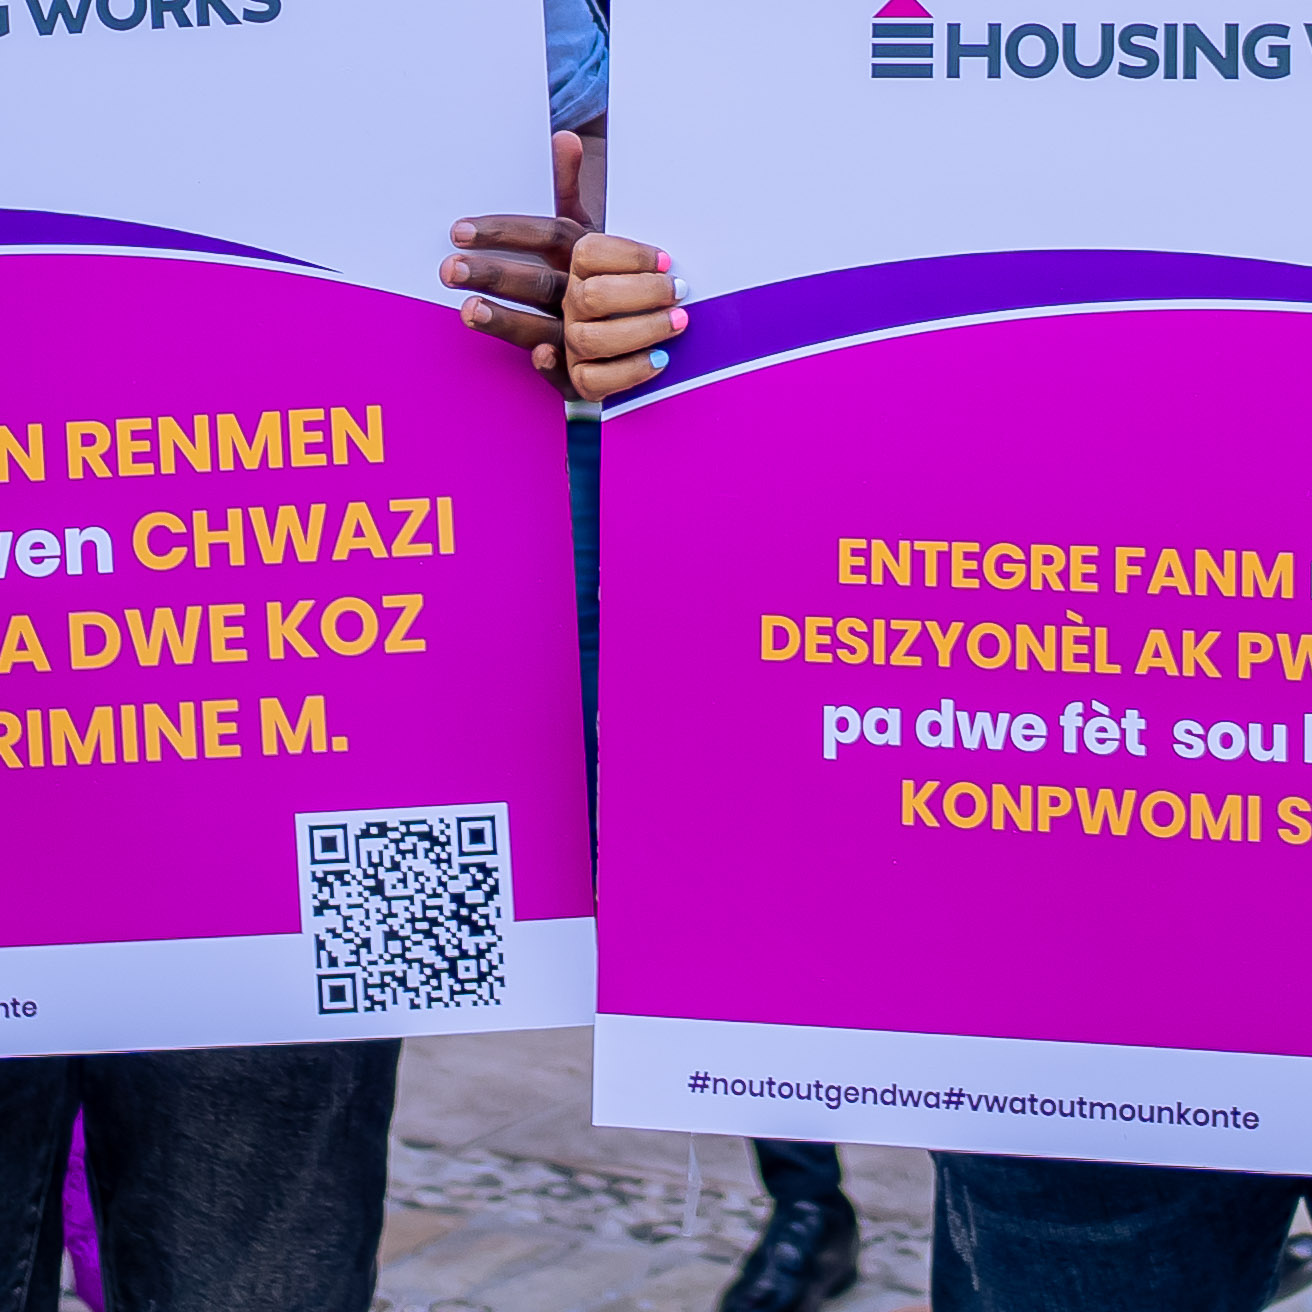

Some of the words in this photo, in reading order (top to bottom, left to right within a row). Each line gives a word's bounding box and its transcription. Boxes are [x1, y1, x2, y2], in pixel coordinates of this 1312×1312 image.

[945, 22, 1291, 80] HOUSING
[66, 405, 384, 479] RENMEN
[133, 497, 454, 570] CHWAZI
[839, 539, 1098, 592] ENTEGRE
[1116, 547, 1293, 598] FANM
[69, 604, 247, 669] DWE
[267, 594, 425, 659] KOZ
[762, 610, 1120, 673] DESIZYONÈL
[1135, 630, 1221, 677] AK
[260, 696, 348, 755] M.
[824, 706, 900, 759] pa
[916, 699, 1047, 751] dwe
[1060, 700, 1146, 756] fèt
[1173, 720, 1286, 762] sou
[902, 780, 1260, 842] KONPWOMI
[688, 1071, 1259, 1129] #noutoutgendwa#vwatoutmounkonte
